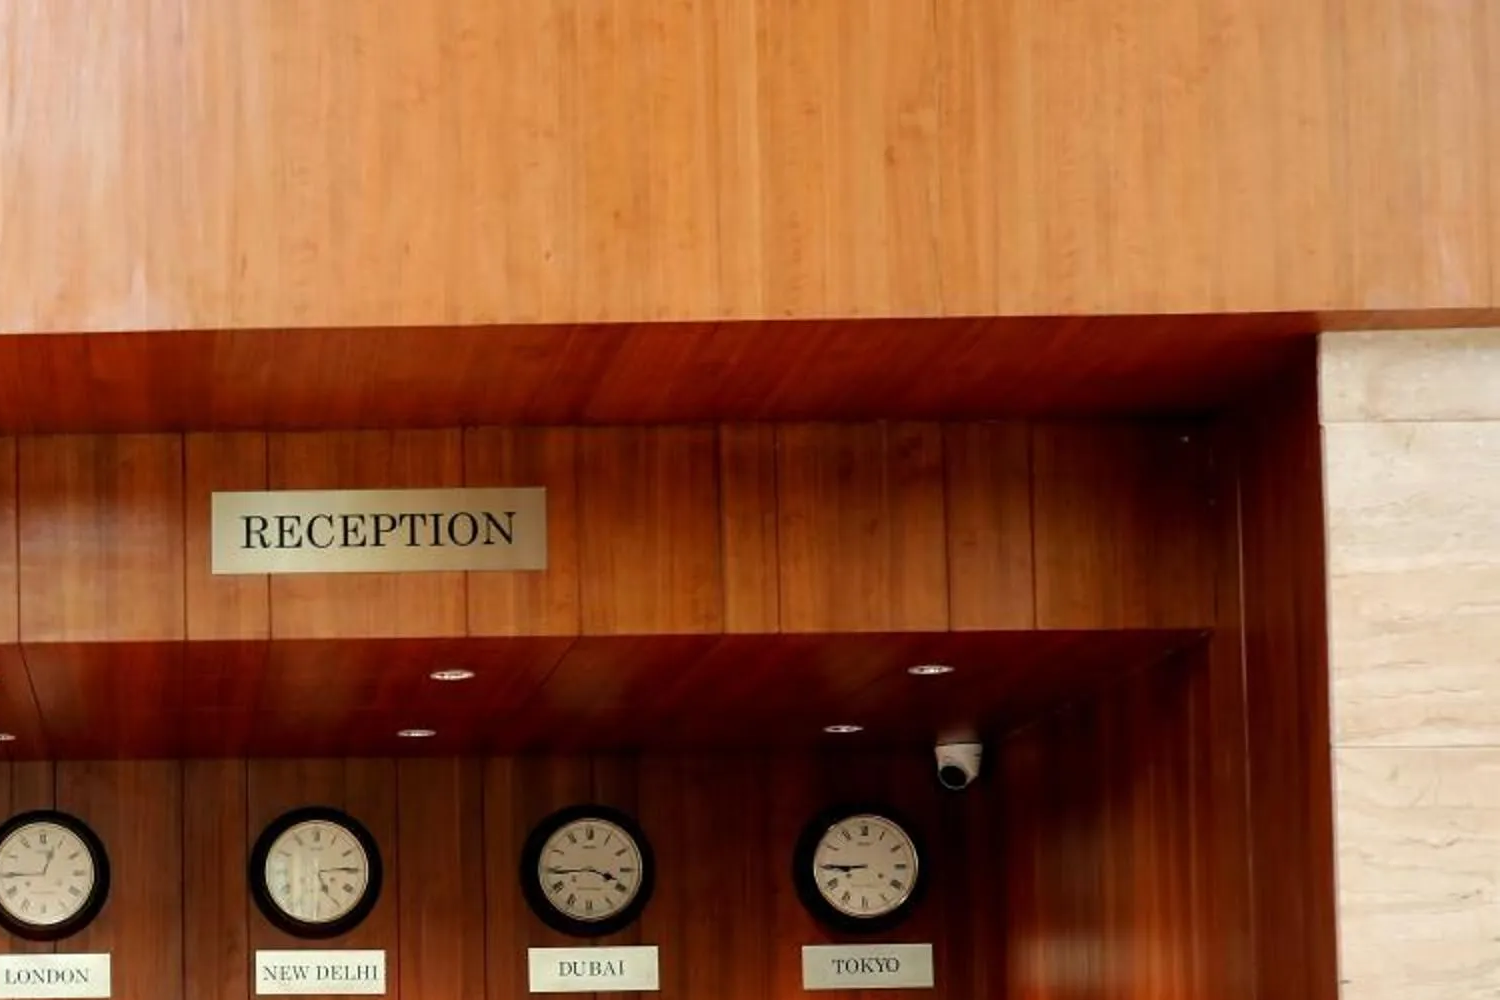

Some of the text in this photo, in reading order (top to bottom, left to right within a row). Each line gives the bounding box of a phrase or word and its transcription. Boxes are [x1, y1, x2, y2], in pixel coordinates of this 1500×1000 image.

[240, 511, 517, 549] RECEPTION
[263, 965, 379, 981] NEW DELHI
[558, 960, 625, 977] DUBAI
[831, 957, 900, 975] TOKYO
[4, 968, 91, 985] LONDON
